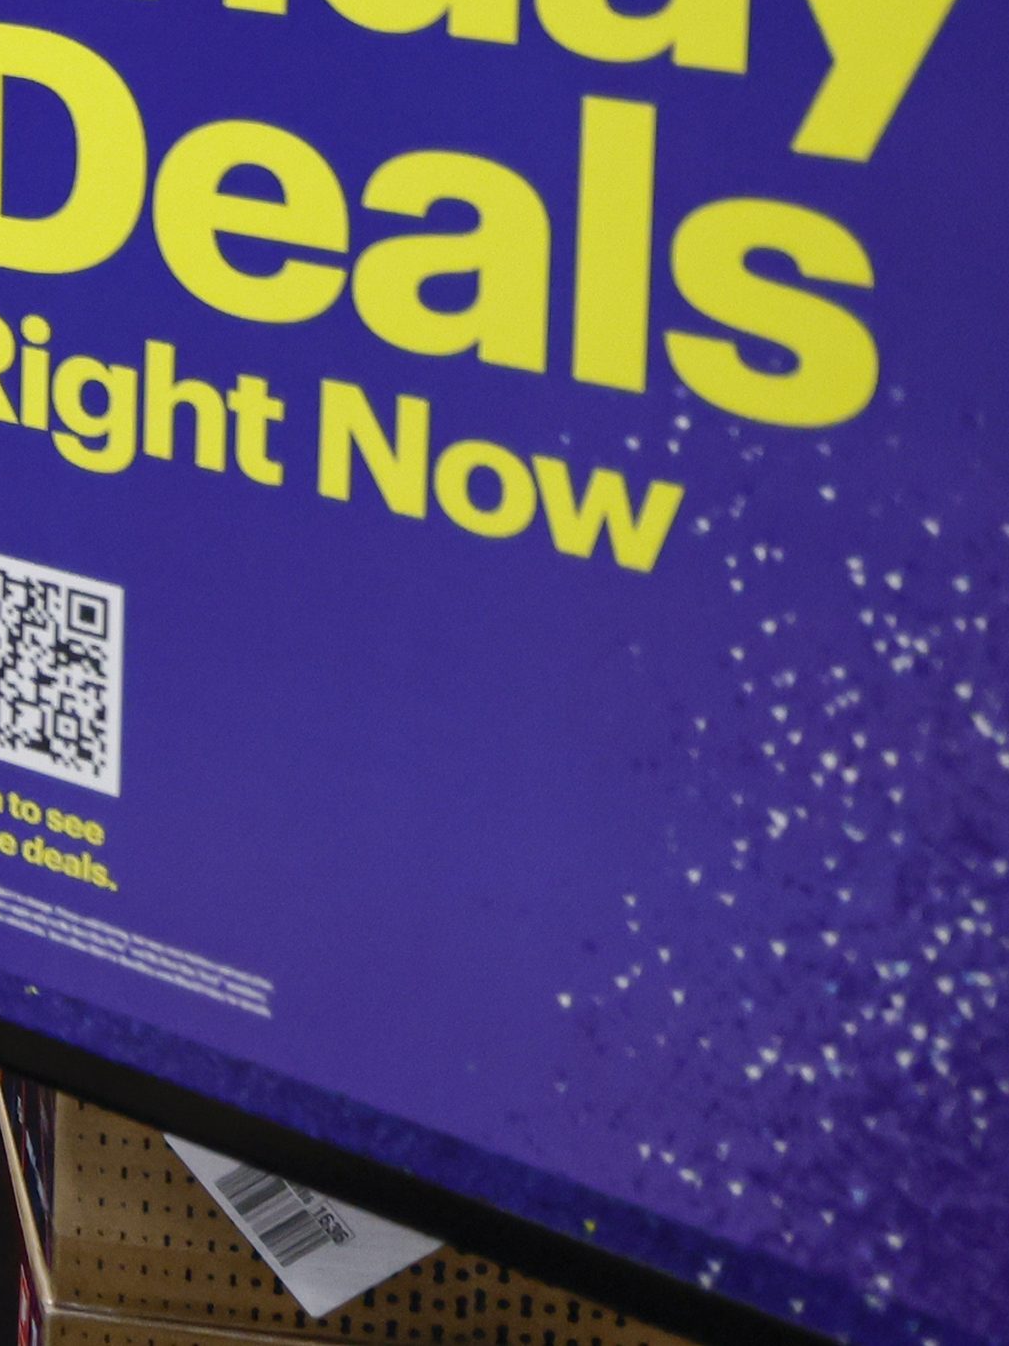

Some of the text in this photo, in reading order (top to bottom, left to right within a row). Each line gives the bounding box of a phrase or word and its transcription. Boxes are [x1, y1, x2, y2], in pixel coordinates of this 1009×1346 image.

[318, 378, 684, 572] Now
[7, 791, 43, 825] to
[45, 807, 106, 846] see
[21, 835, 118, 892] deals.
